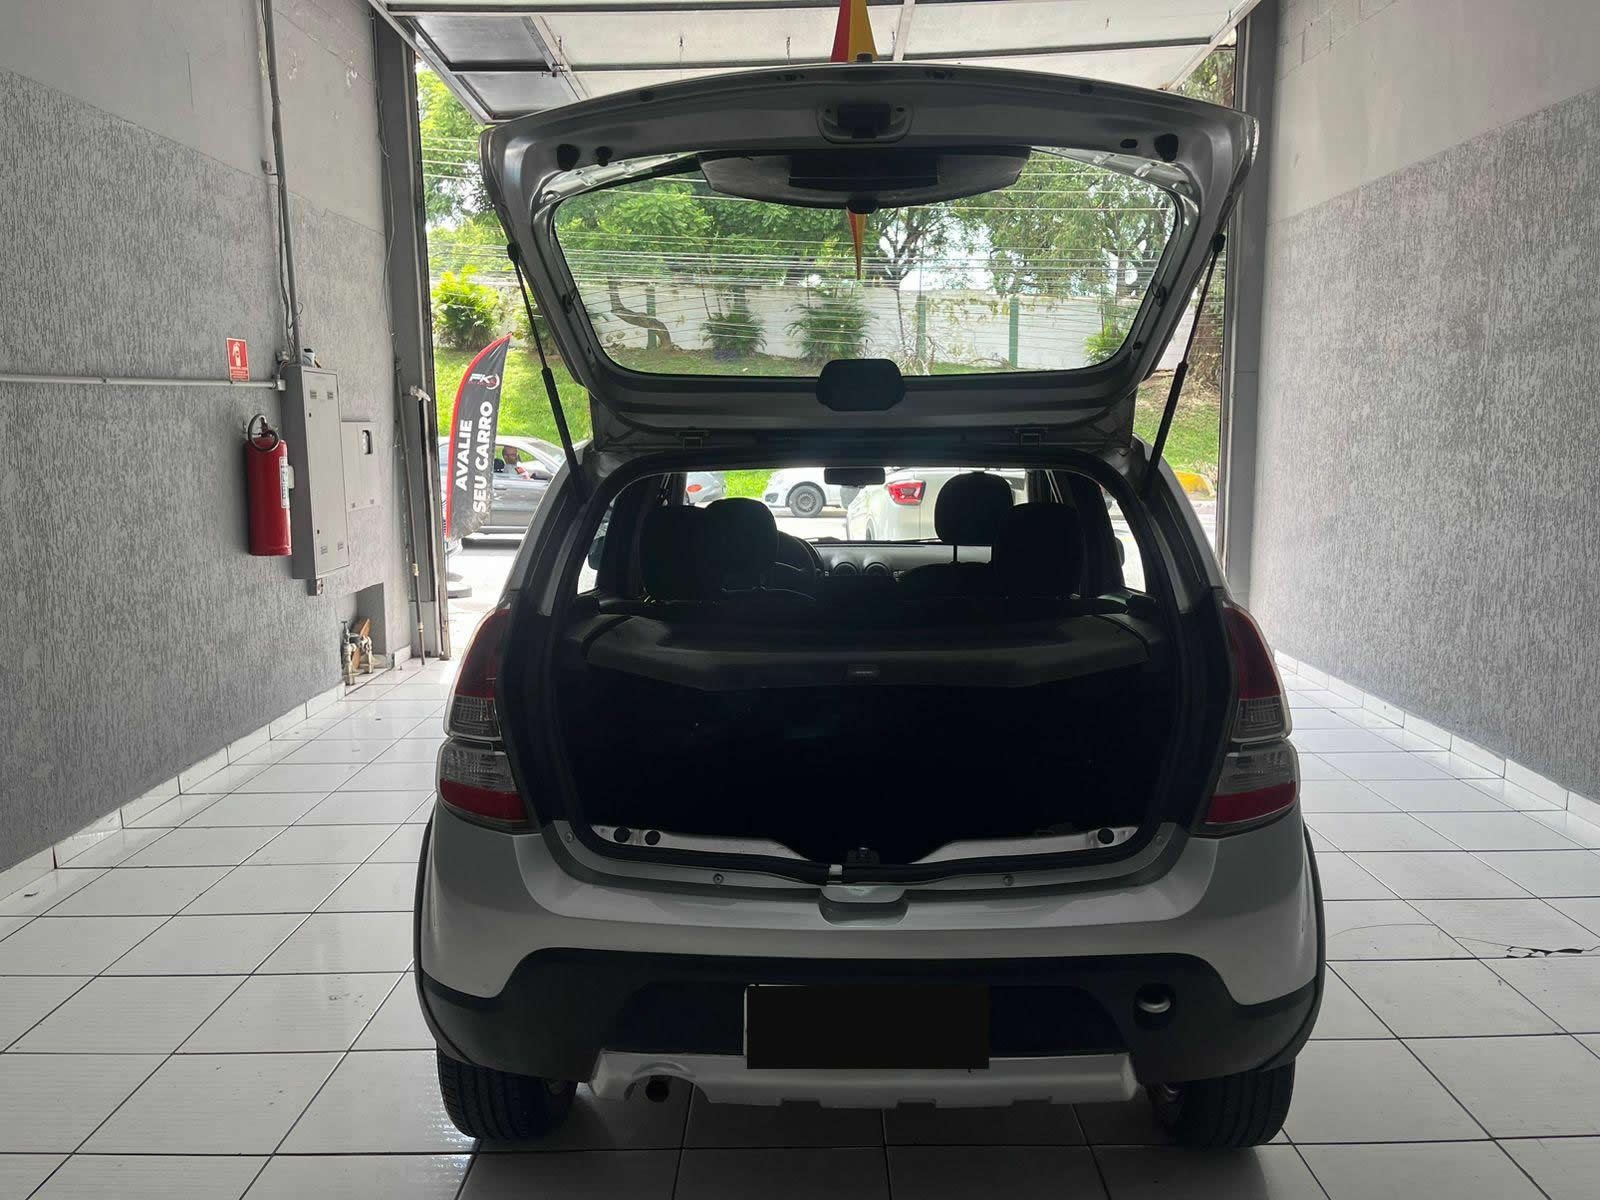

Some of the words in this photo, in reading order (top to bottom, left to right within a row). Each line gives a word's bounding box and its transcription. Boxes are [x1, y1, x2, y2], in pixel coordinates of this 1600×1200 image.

[455, 420, 473, 491] AVALIE
[475, 401, 493, 471] CARRO
[472, 475, 488, 512] SEU
